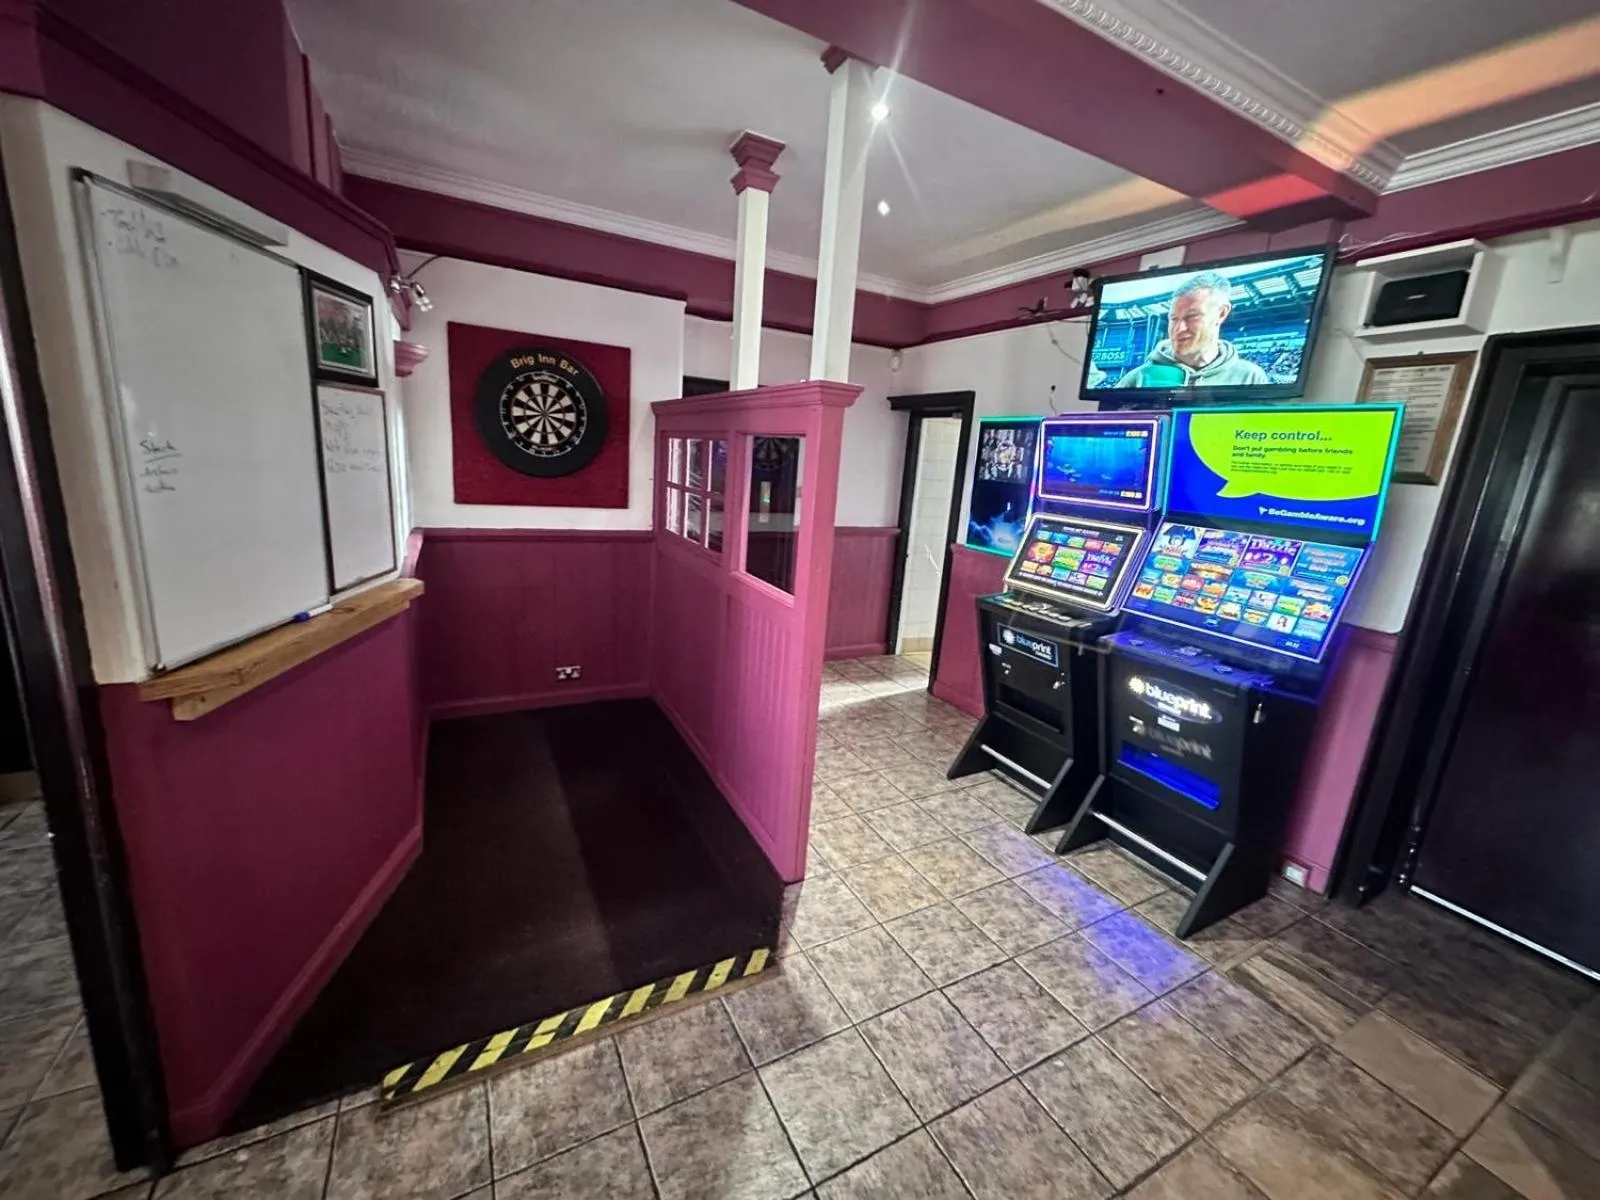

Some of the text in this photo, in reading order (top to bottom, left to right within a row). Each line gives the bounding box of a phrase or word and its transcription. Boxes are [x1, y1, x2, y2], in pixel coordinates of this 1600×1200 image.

[510, 354, 579, 376] Brig Inn Bar
[1235, 430, 1332, 442] Keep control...
[1251, 445, 1262, 453] put
[1263, 446, 1297, 454] gambling
[1268, 508, 1366, 526] BeGambleAware.org
[1250, 538, 1297, 556] Dazzle
[1016, 634, 1052, 655] blueprint
[1145, 681, 1213, 720] blueprint
